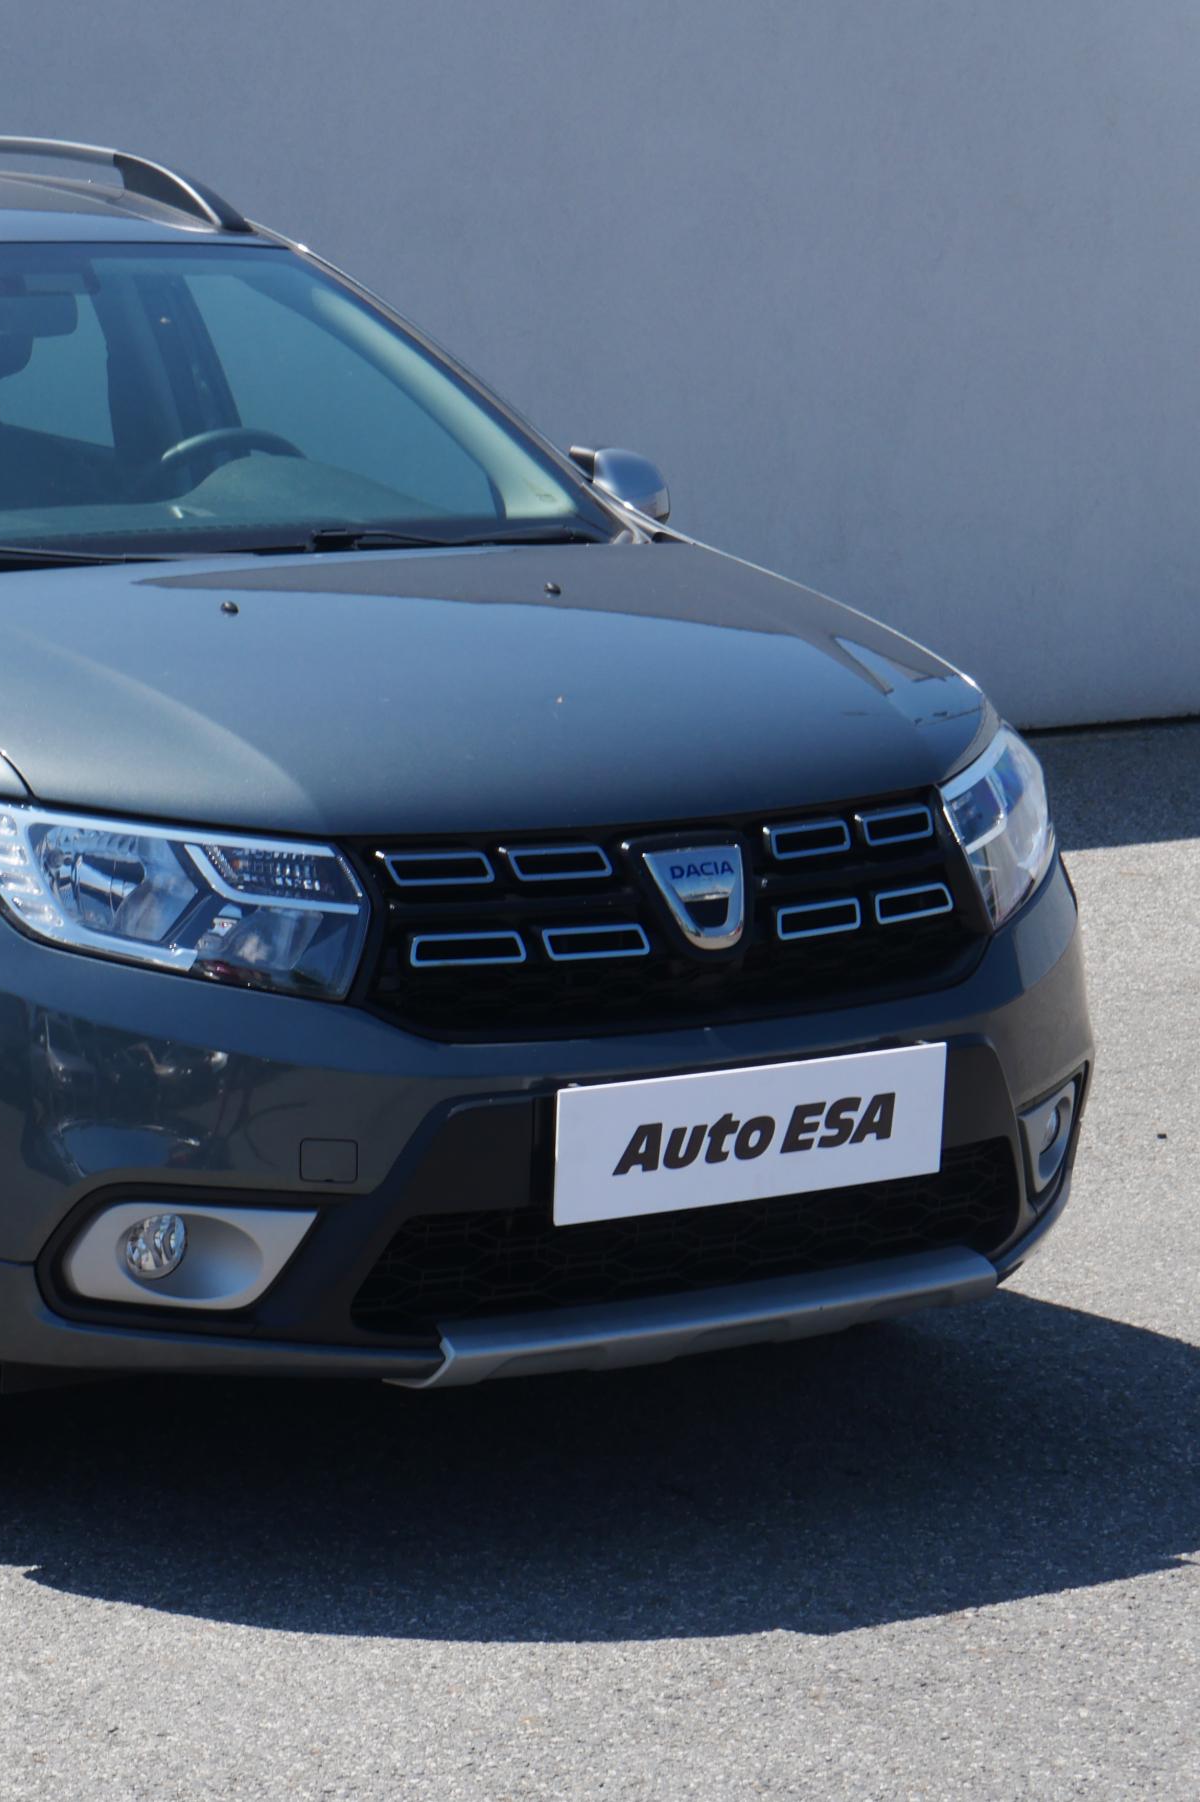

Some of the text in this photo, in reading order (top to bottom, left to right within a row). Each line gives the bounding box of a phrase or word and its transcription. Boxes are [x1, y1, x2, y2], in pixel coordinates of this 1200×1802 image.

[669, 860, 734, 880] DACIA
[612, 1092, 896, 1176] Auto ESA
